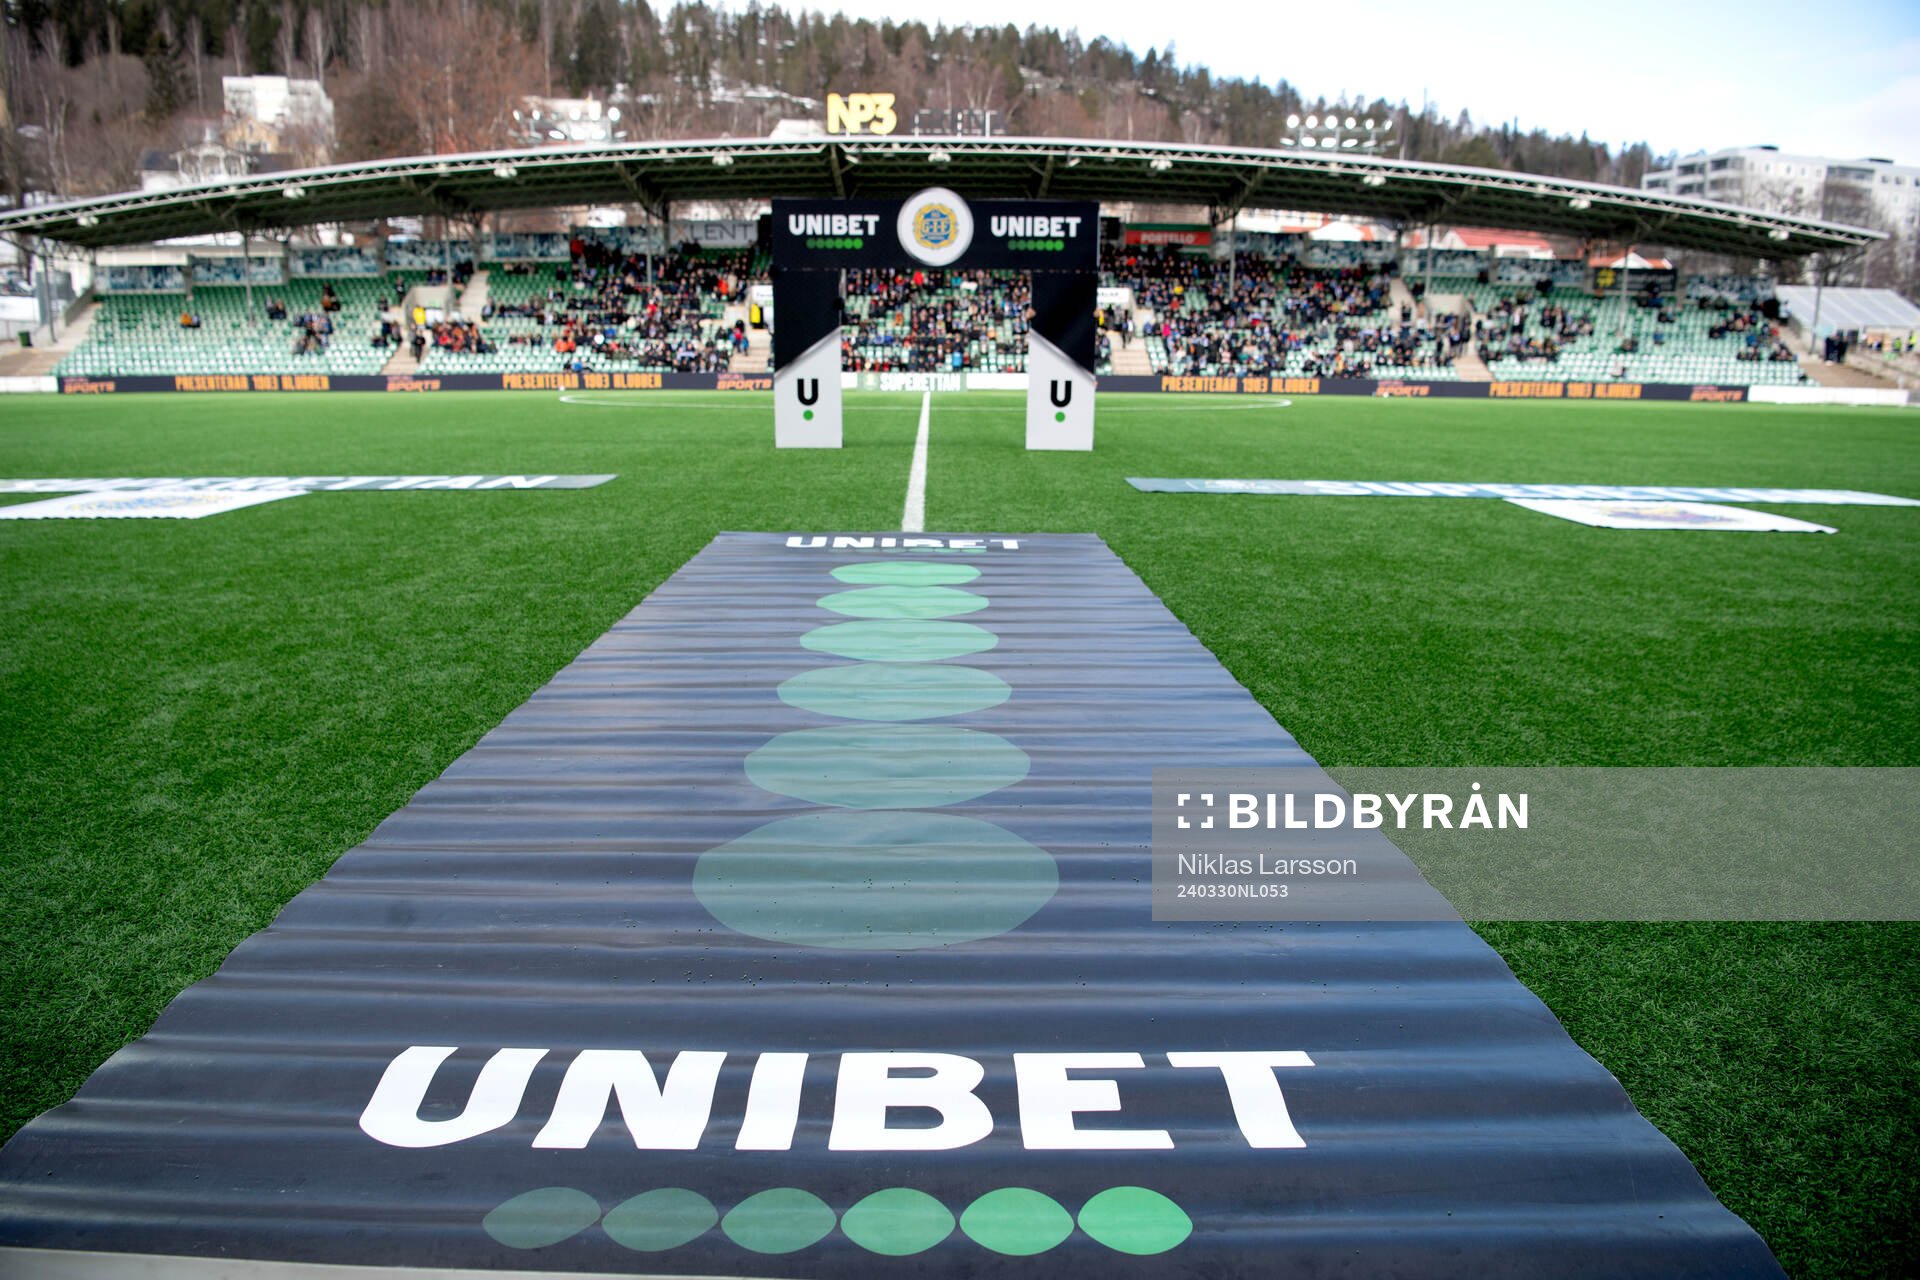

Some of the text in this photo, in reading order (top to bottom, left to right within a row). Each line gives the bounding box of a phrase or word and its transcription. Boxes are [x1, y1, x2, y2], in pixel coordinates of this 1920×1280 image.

[826, 92, 897, 136] NP3
[672, 223, 753, 241] XLENT
[788, 214, 880, 236] UNIBET
[991, 216, 1081, 238] UNIBET
[387, 379, 441, 392] SPORTS
[717, 378, 773, 391] SPORTS
[797, 378, 818, 406] U
[879, 372, 961, 391] SUPERETTAN
[1050, 380, 1072, 407] U
[785, 536, 1023, 550] UNIBET
[358, 1045, 1315, 1151] UNIBET
